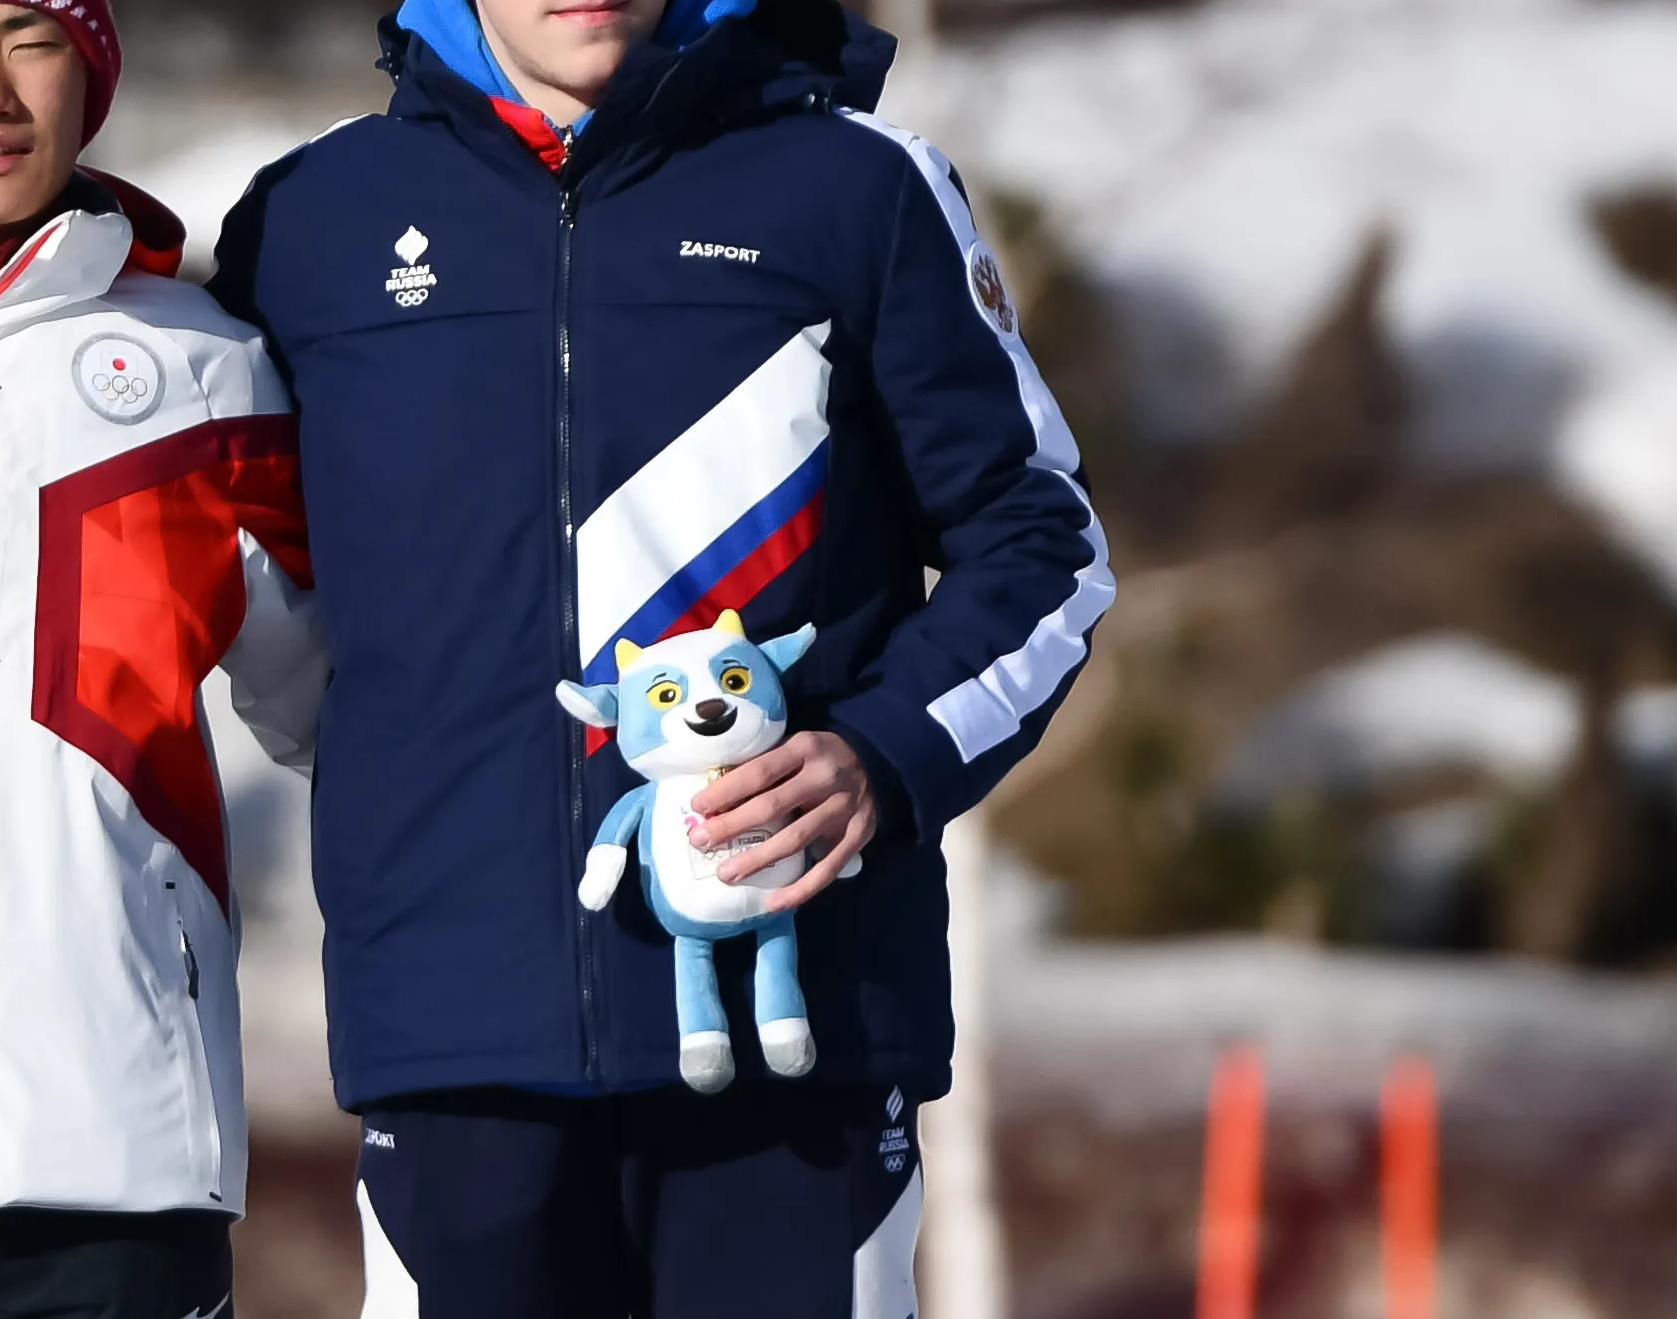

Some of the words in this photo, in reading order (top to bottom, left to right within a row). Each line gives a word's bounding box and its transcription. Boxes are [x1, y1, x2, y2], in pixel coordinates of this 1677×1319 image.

[679, 240, 761, 264] ZASPORT
[390, 263, 430, 279] TEAM
[385, 273, 437, 292] RUSSIA
